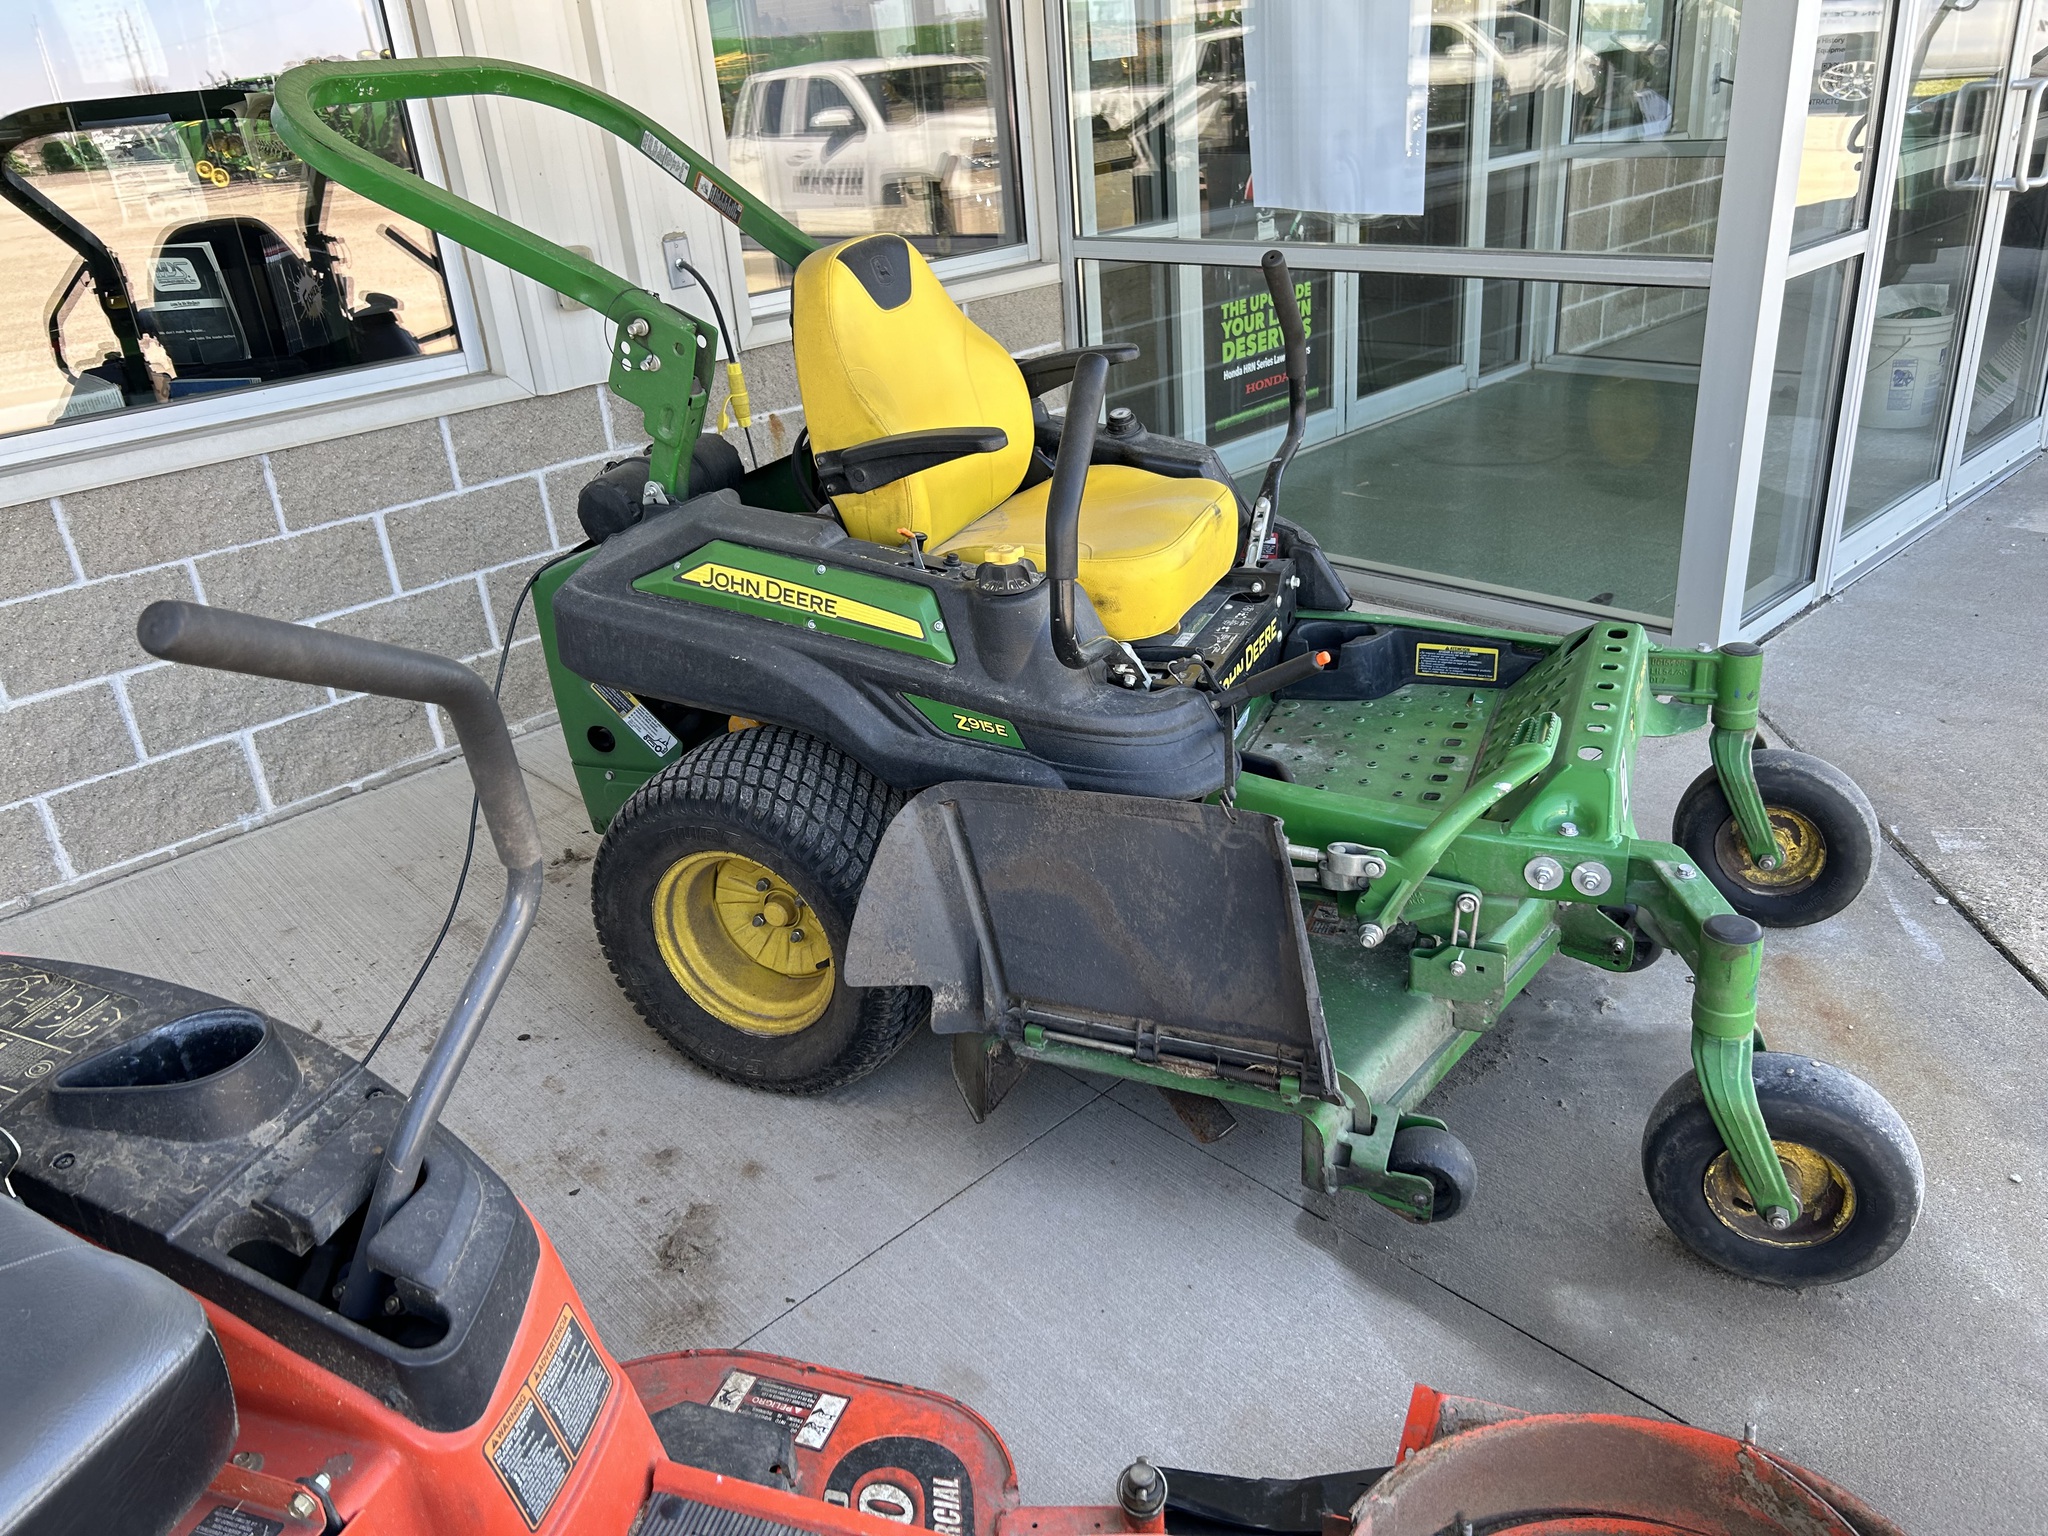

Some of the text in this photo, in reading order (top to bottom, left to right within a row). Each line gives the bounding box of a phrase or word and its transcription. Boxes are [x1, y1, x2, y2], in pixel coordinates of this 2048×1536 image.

[797, 168, 864, 195] MARTIN
[1221, 298, 1247, 319] THE
[1221, 312, 1265, 339] YOUR
[1223, 366, 1243, 381] Honda
[1243, 361, 1256, 375] HRN
[1257, 357, 1273, 370] Series
[1245, 372, 1289, 395] HONDA
[703, 567, 837, 615] JOHN DEERE
[1219, 658, 1244, 690] OHN
[1245, 617, 1278, 672] DEERE
[952, 713, 1009, 738] Z915E
[537, 1313, 568, 1373] ADVERTENCIA
[495, 1392, 527, 1440] WARNING
[751, 1396, 793, 1413] PELIGRO
[493, 1399, 533, 1460] TO AVOID SERIOUS
[513, 1428, 520, 1440] OR
[519, 1406, 534, 1429] DEATH
[933, 1477, 961, 1536] RCIAL
